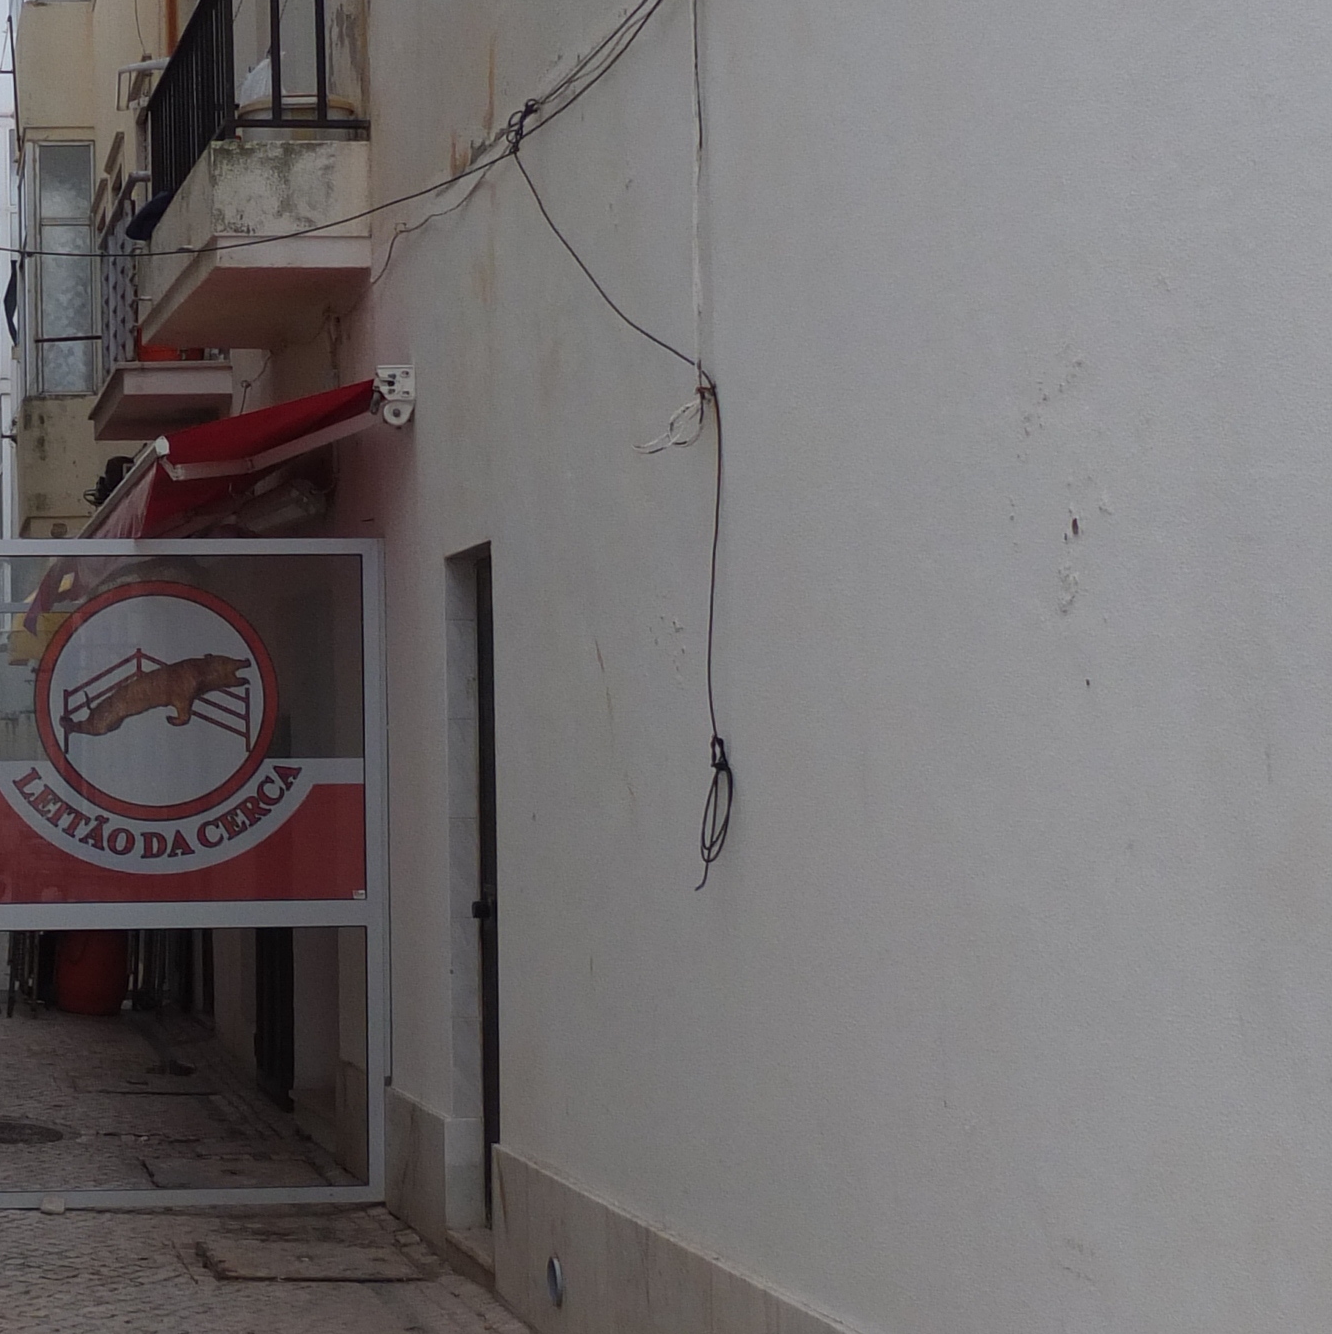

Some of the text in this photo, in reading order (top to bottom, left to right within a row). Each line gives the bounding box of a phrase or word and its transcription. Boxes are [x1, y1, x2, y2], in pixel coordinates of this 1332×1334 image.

[12, 765, 302, 859] LEITÃO DA CERCA
